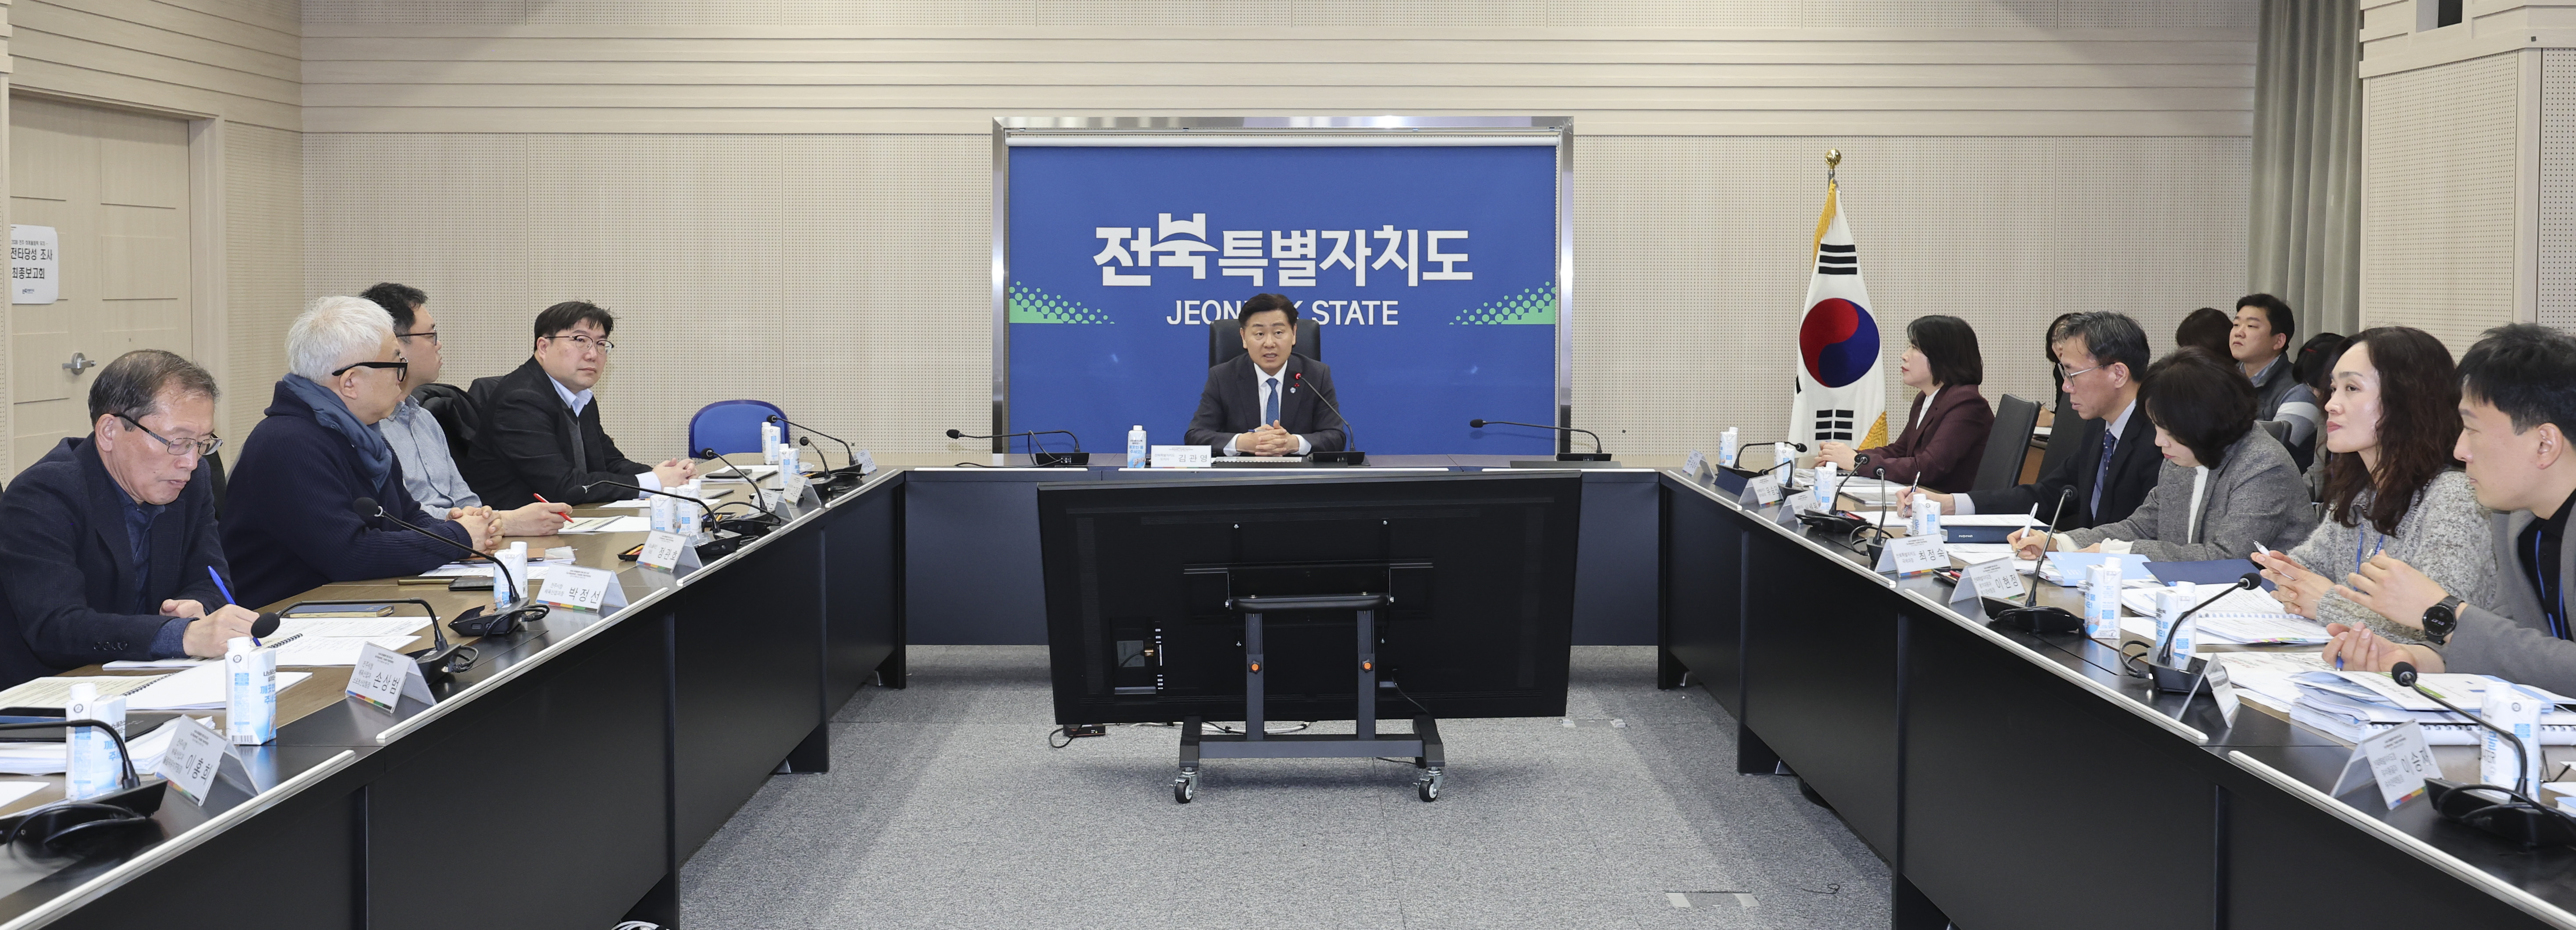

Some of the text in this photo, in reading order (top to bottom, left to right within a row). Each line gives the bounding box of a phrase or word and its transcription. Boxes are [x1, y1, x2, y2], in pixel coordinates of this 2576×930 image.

[40, 249, 52, 261] 조사
[1093, 213, 1473, 286] 전북특별자치도
[12, 267, 45, 279] 최종보고회
[1167, 300, 1398, 325] JEON STATE
[1919, 548, 1946, 561] 최정숙
[1995, 574, 2018, 590] 이현정
[569, 587, 601, 604] 박정선
[373, 672, 400, 695] 손상범
